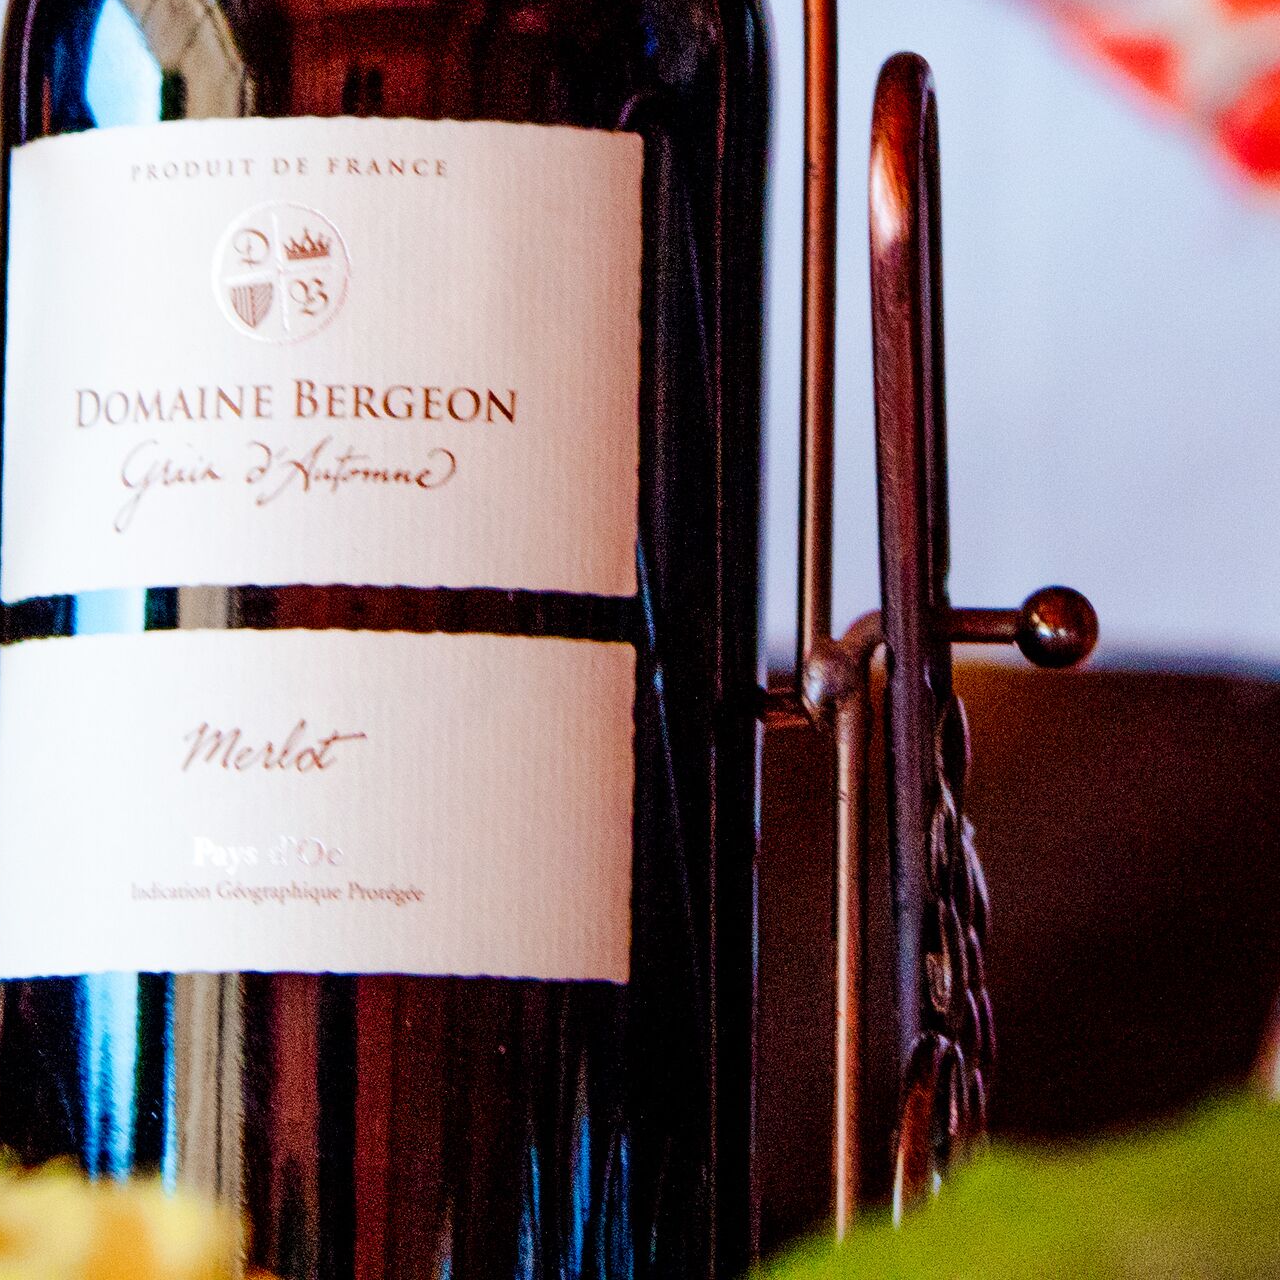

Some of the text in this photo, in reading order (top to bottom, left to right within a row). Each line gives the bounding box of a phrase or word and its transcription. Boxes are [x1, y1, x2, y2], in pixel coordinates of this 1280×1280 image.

[130, 157, 450, 183] PRODUIT DE FRANCE
[75, 378, 517, 428] DOMAINE BERGEON
[245, 433, 458, 508] d'Automne
[182, 719, 368, 773] Merlot
[191, 835, 259, 876] Pays
[130, 881, 212, 903] Indication
[216, 879, 342, 905] Géographique
